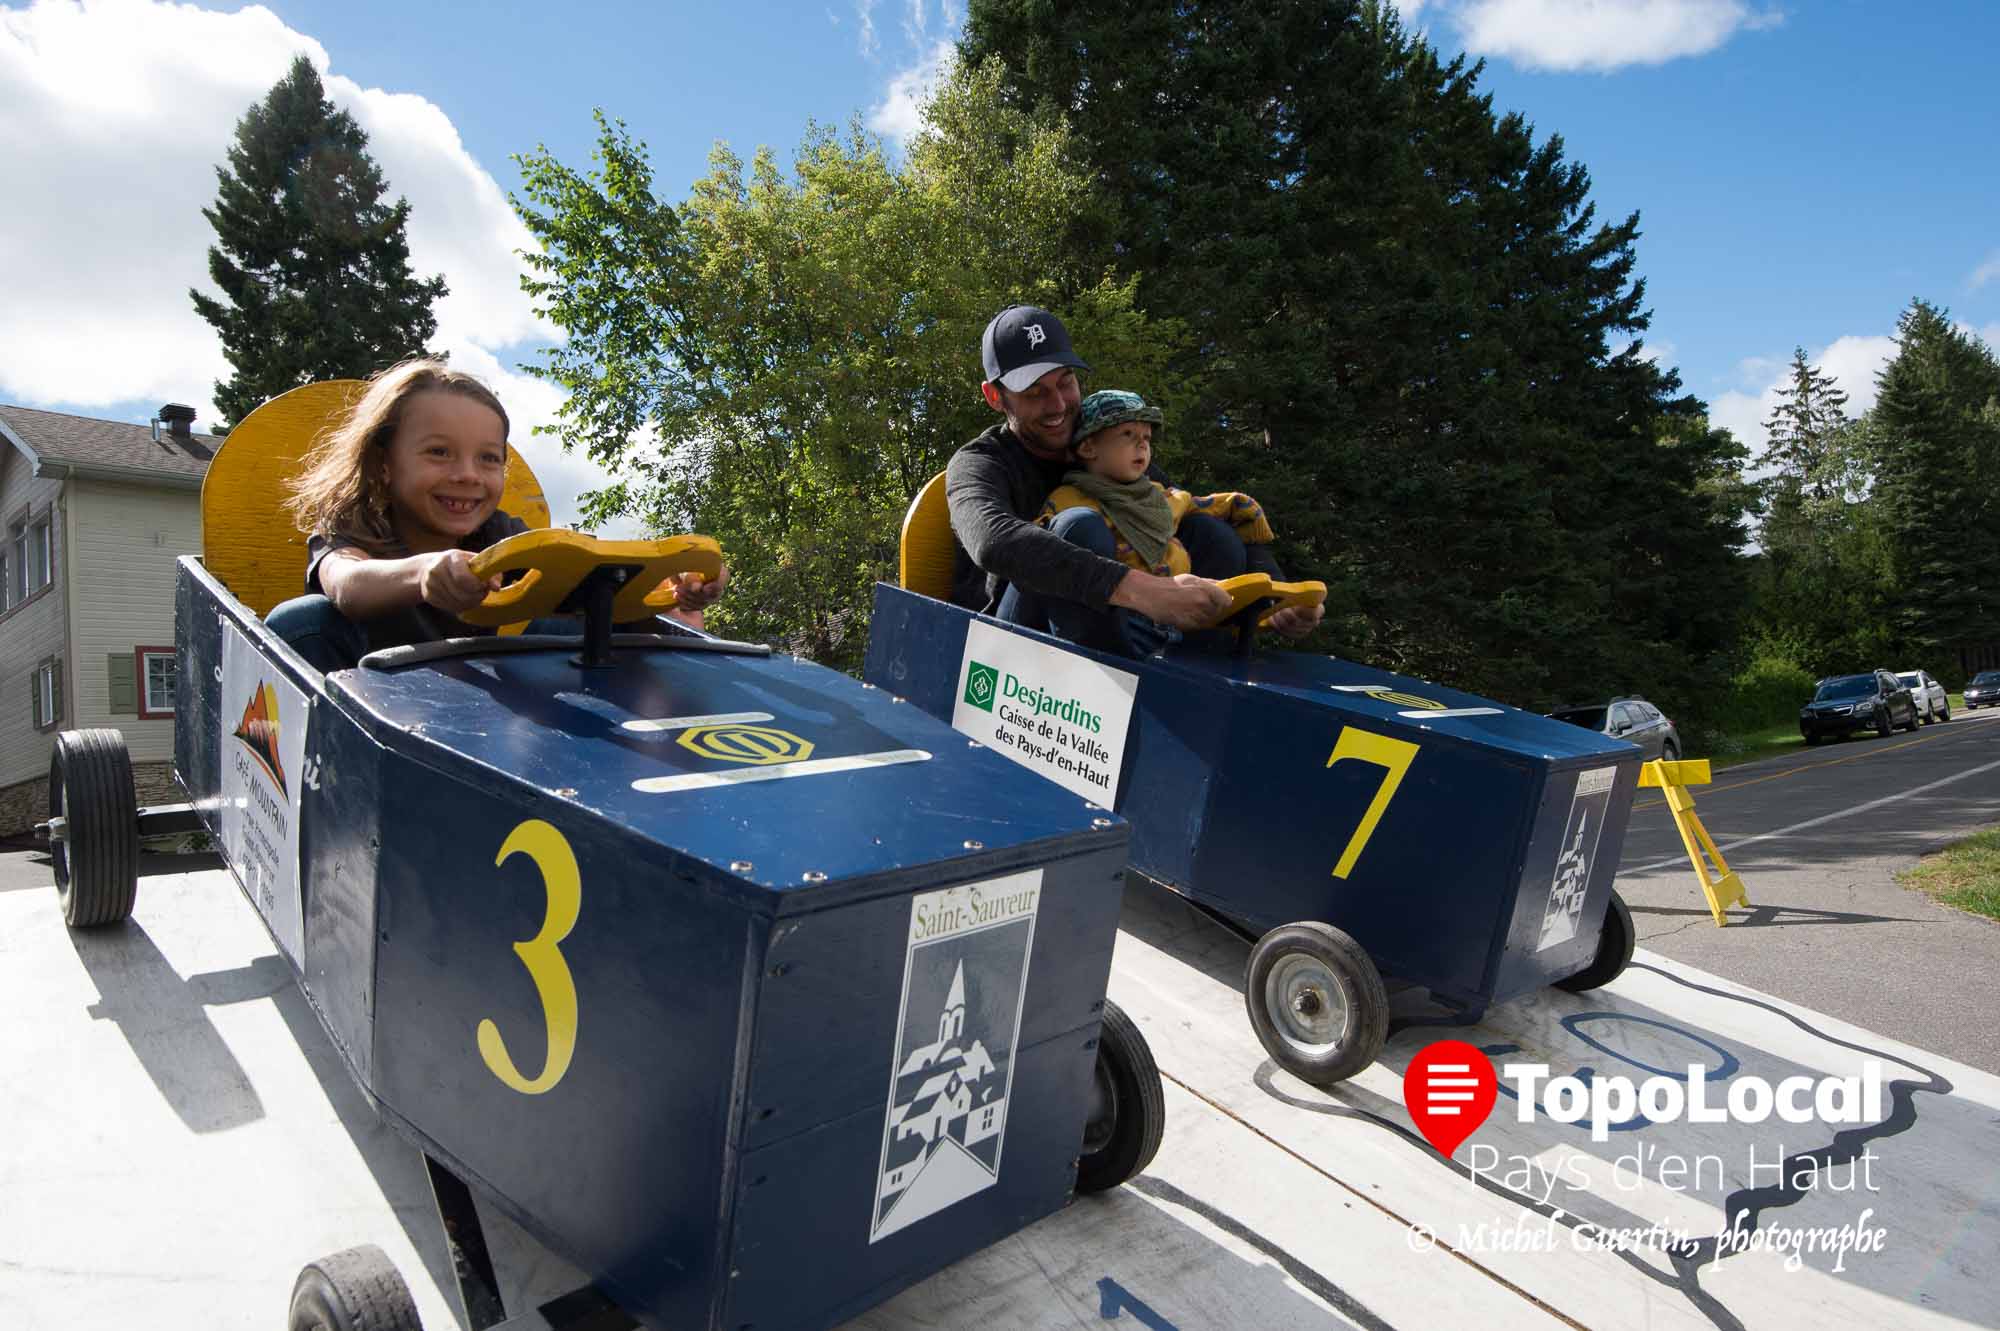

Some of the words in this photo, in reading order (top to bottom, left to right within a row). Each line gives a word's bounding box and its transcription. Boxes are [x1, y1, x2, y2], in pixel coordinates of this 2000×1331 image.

[1022, 323, 1047, 351] D
[999, 704, 1035, 731] Caisse
[1038, 720, 1053, 739] de
[1056, 726, 1068, 746] la
[1071, 733, 1109, 764] Vallée
[1003, 674, 1102, 734] Desjardins
[995, 725, 1014, 746] des
[1017, 734, 1111, 789] Pays-d'en-Haut
[249, 775, 288, 840] MOUNTAIN
[1326, 726, 1421, 880] 7
[914, 888, 1036, 940] Saint-Sauveur
[477, 819, 582, 1095] 3
